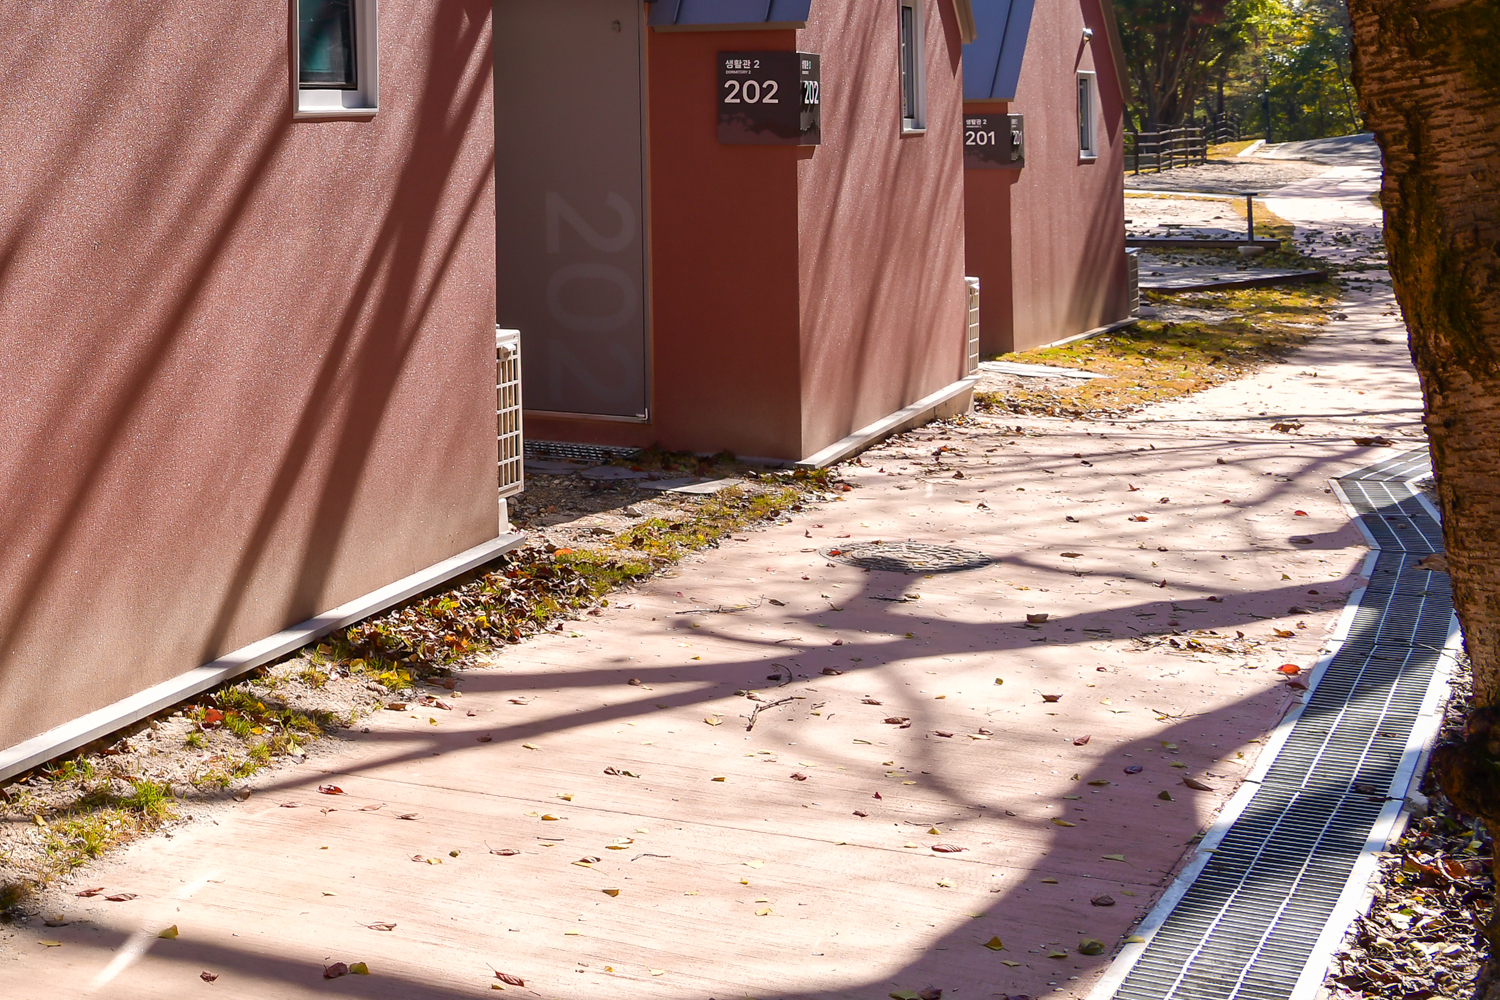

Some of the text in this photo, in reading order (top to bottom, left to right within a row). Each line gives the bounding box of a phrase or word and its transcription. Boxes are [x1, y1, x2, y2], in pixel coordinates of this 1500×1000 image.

[725, 59, 760, 70] 생활관 2
[724, 80, 779, 104] 202
[804, 80, 819, 104] 202
[965, 131, 995, 145] 201
[545, 191, 639, 404] 202
